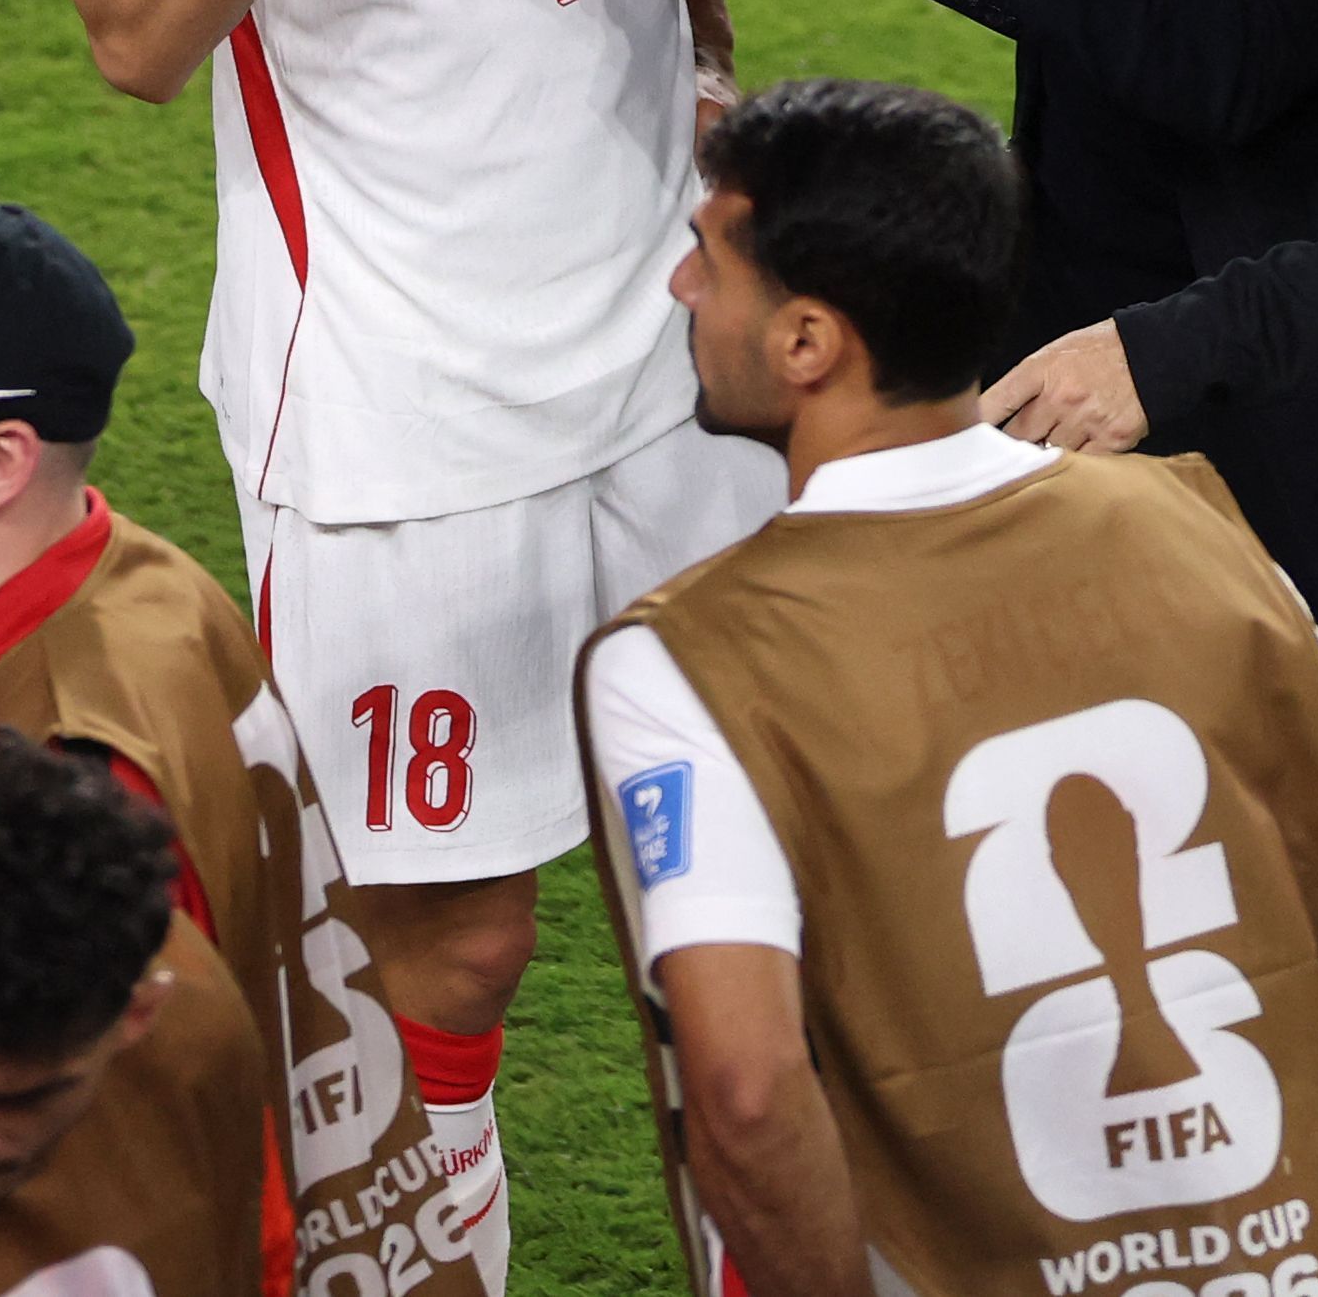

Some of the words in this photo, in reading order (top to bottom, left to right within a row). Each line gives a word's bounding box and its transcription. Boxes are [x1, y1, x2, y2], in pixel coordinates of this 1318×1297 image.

[352, 685, 476, 832] 18
[1104, 1102, 1232, 1169] FIFA
[1039, 1225, 1231, 1296] WORLD
[1237, 1199, 1310, 1257] CUP
